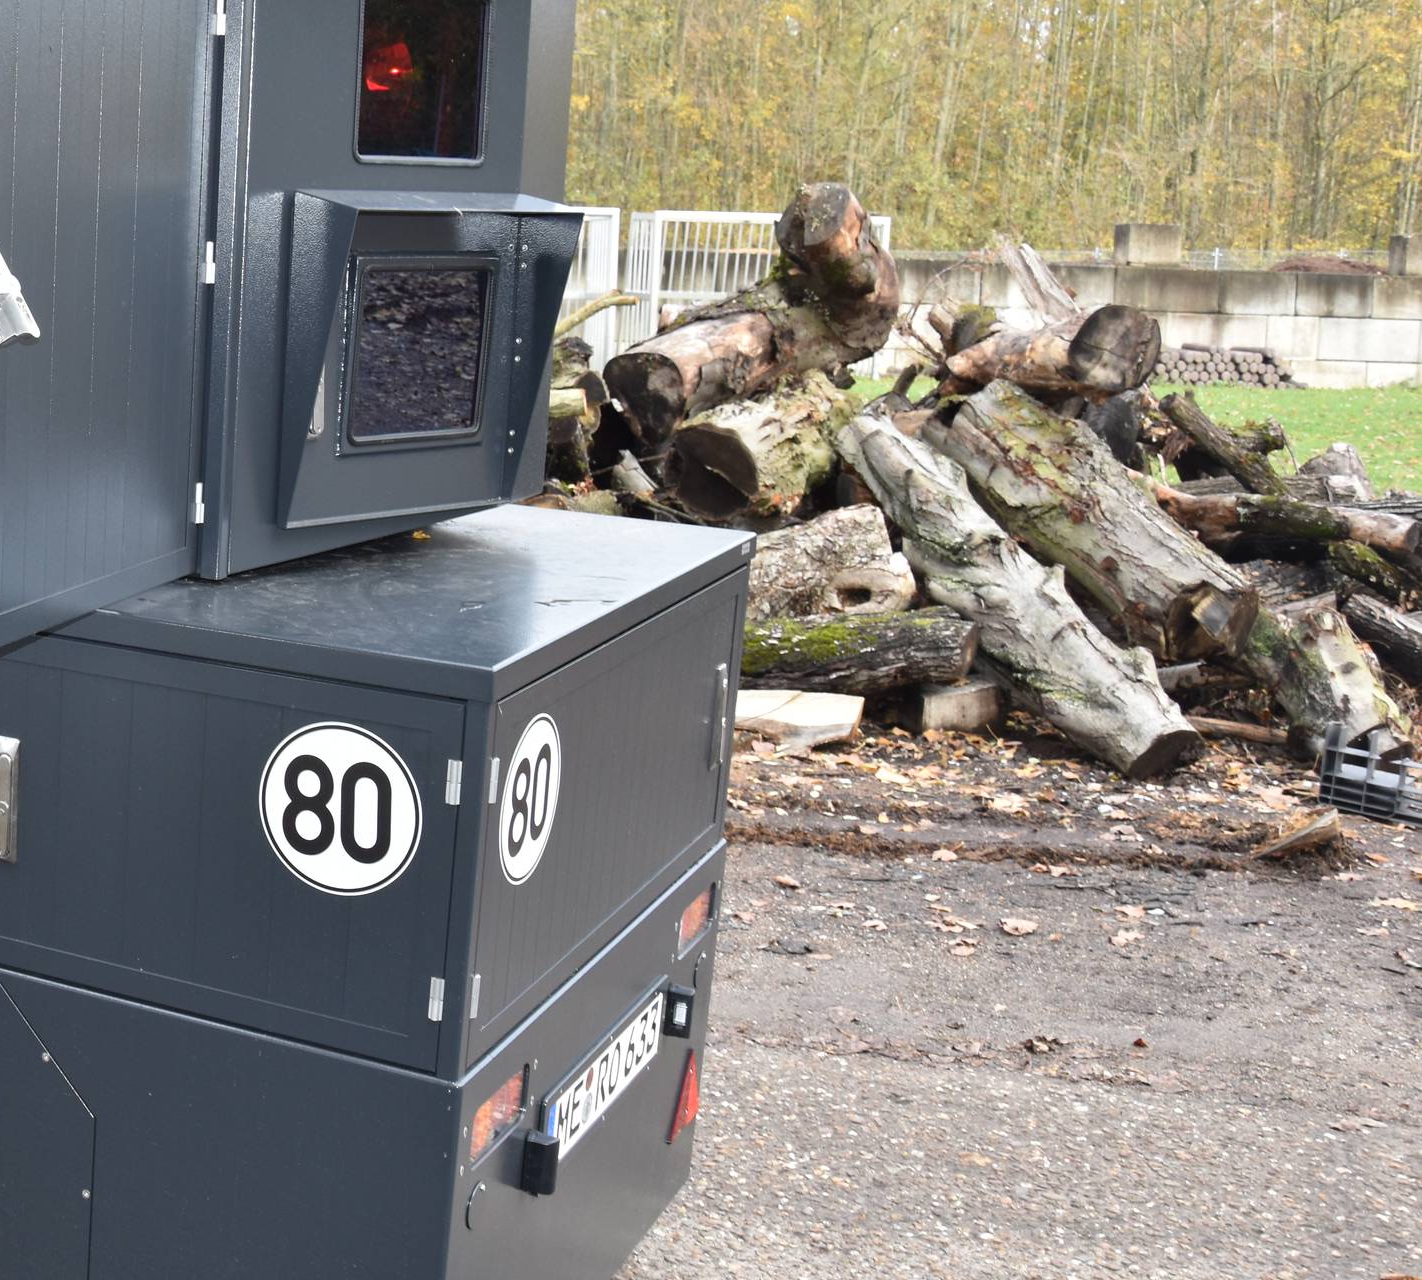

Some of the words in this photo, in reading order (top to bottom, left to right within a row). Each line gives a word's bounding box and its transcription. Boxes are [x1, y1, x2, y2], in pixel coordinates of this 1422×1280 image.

[282, 754, 392, 864] 80
[507, 743, 552, 857] 80
[556, 1080, 584, 1145] ME
[595, 1041, 621, 1111] RO
[624, 1001, 659, 1077] 633
